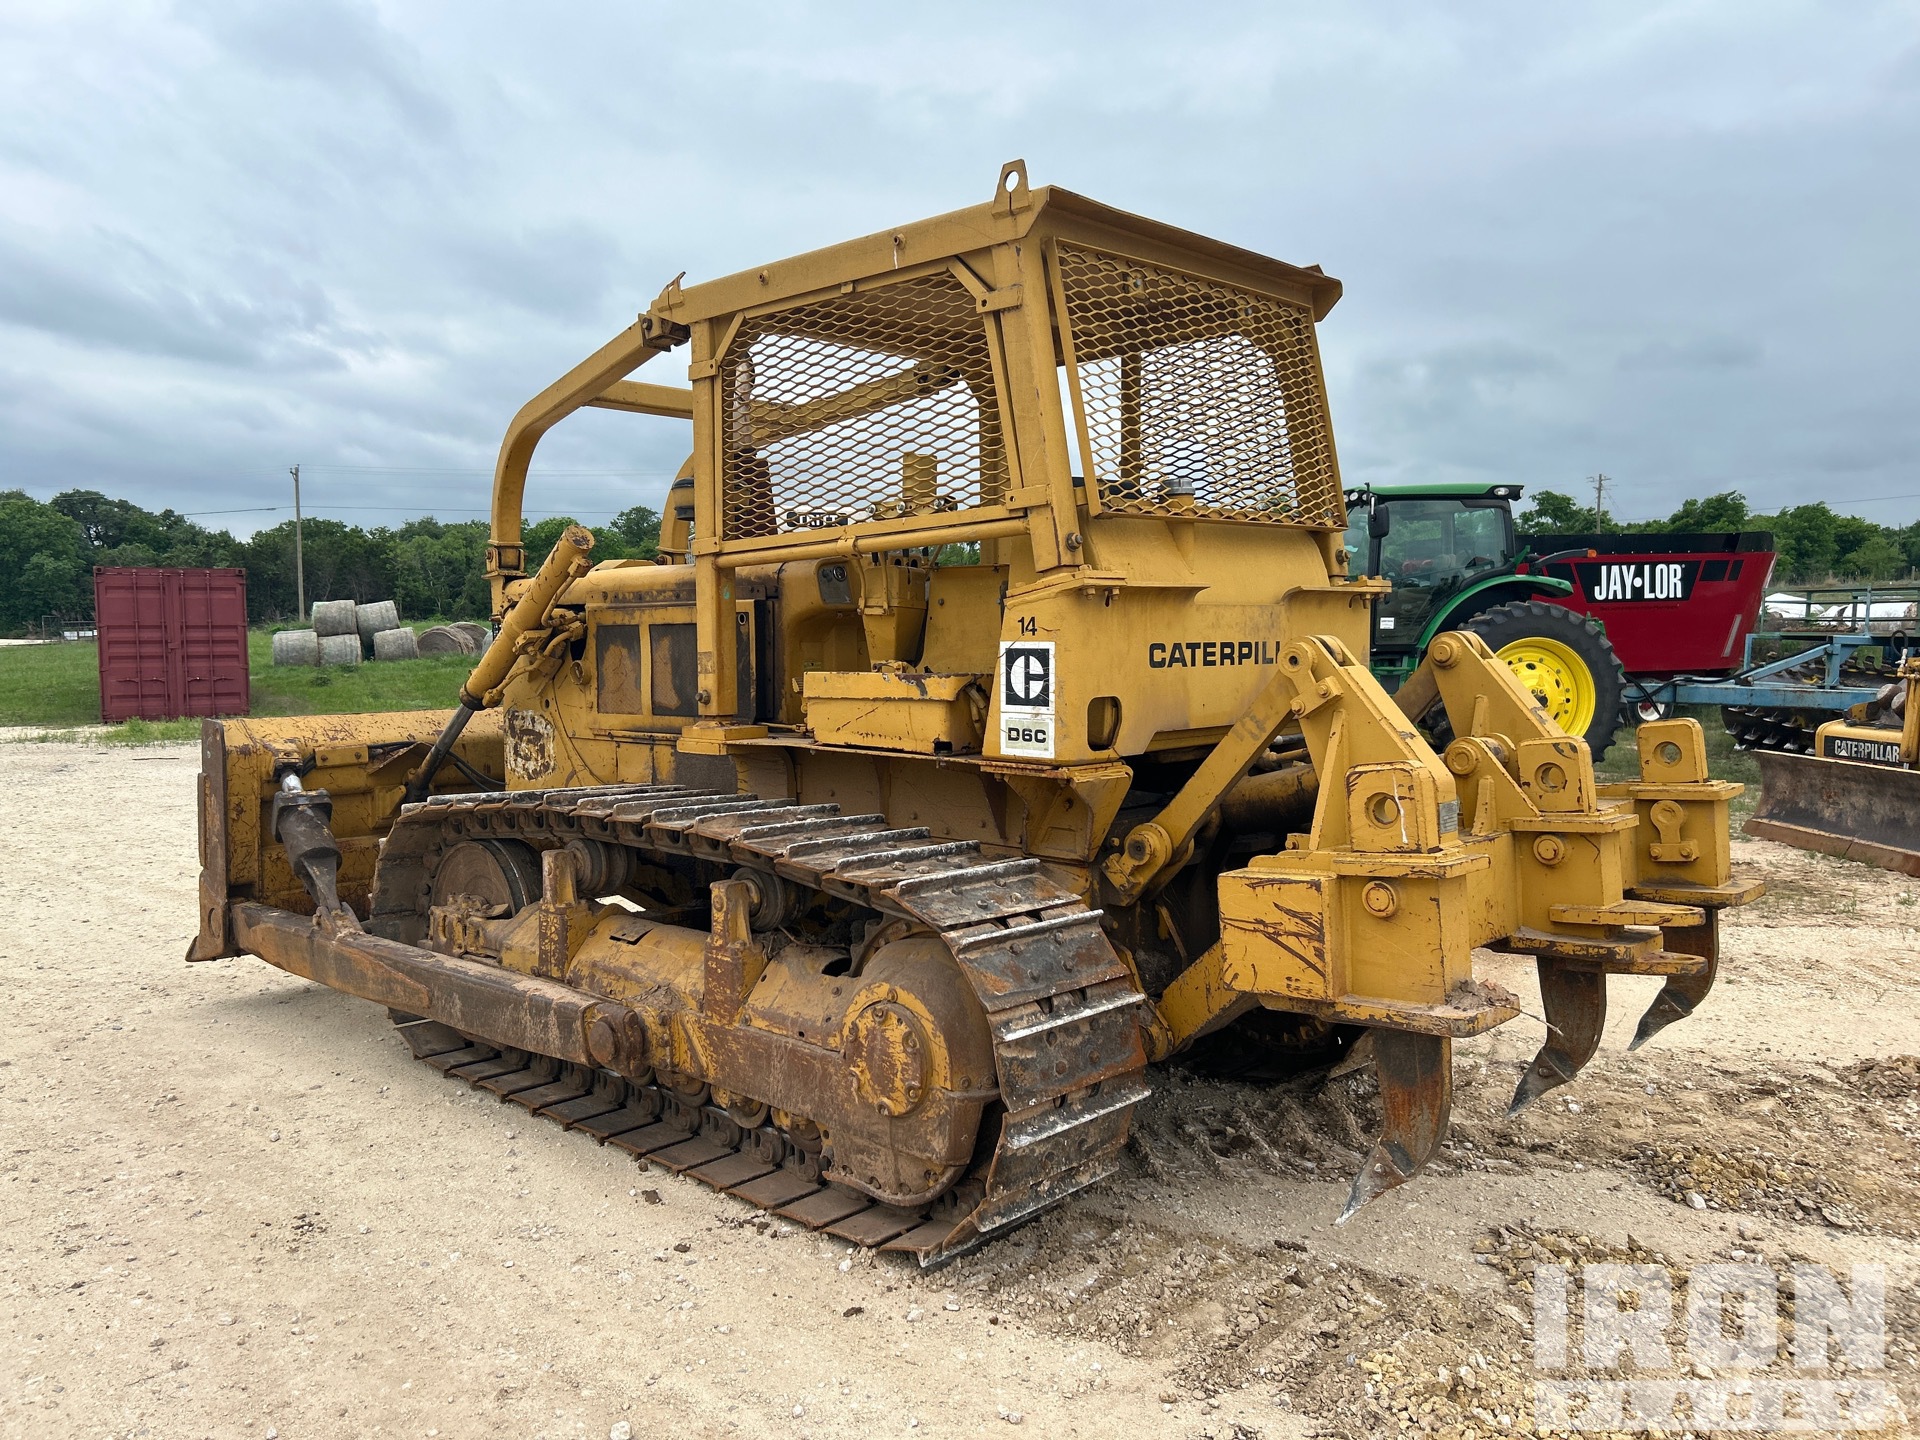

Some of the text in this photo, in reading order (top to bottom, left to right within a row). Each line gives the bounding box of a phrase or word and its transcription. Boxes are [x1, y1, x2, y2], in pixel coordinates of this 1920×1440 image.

[1017, 616, 1037, 636] 14
[1007, 727, 1046, 743] D6C
[1834, 739, 1899, 763] CATERPILLAR
